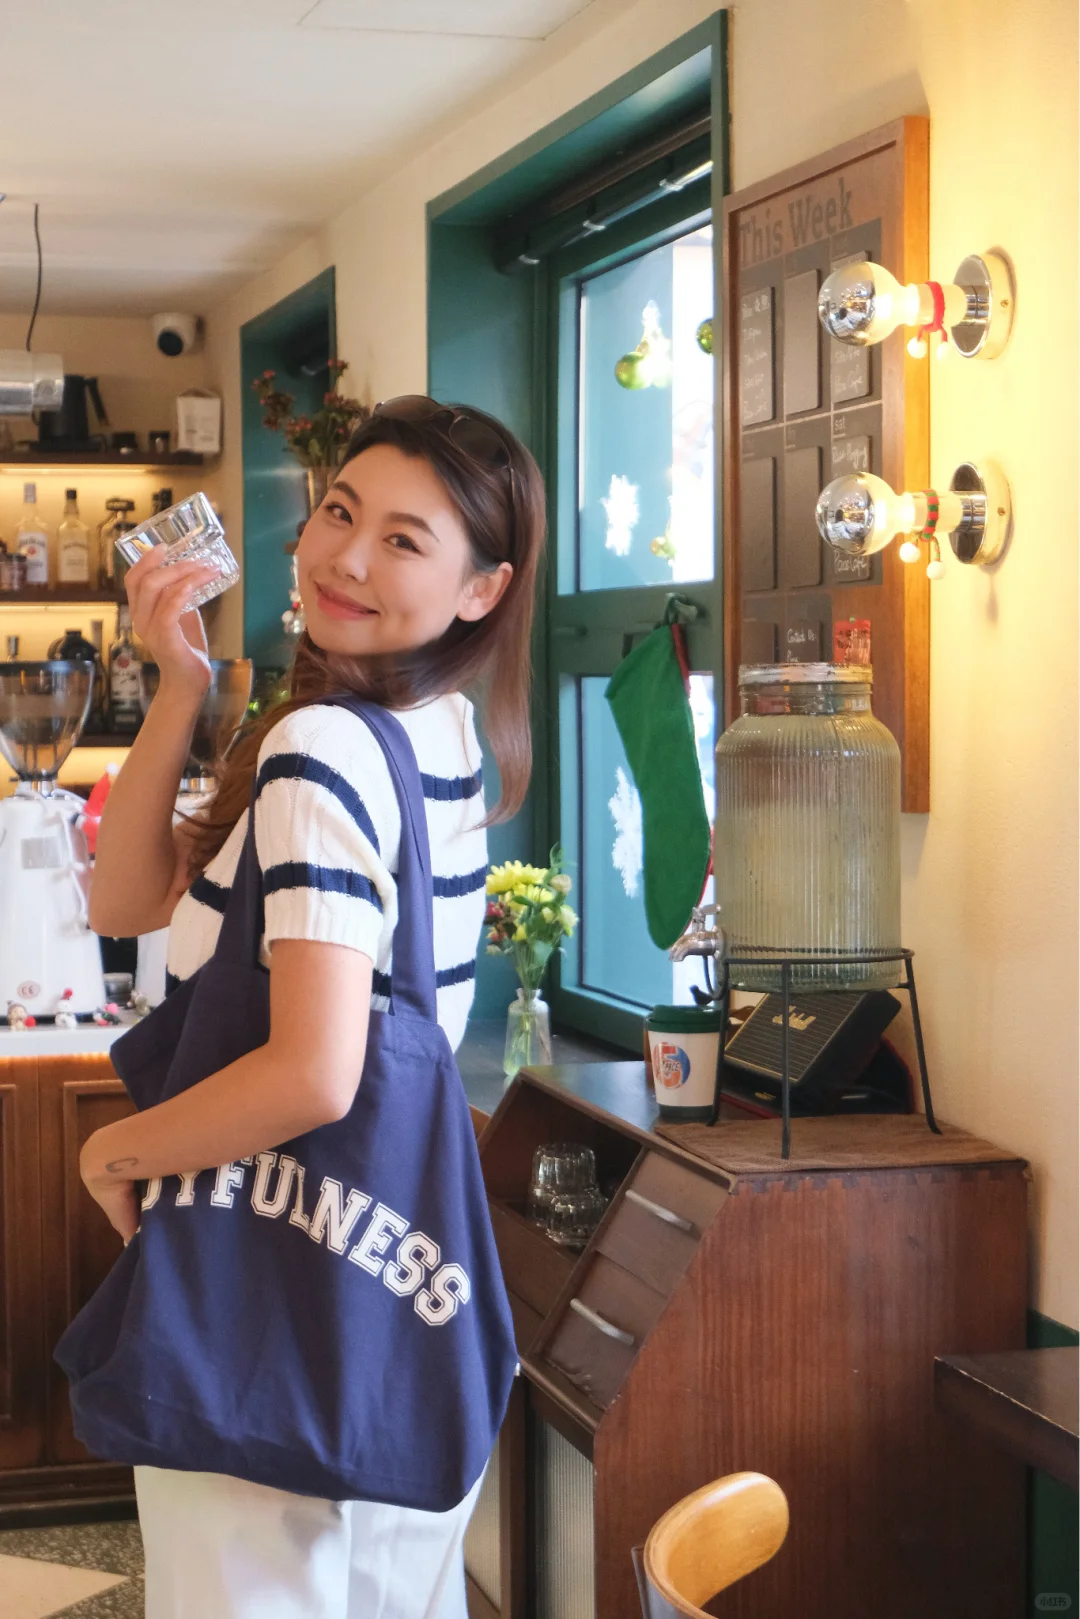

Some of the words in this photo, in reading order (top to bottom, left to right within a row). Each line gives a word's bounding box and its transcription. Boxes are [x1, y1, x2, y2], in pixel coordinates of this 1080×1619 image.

[739, 208, 783, 266] This
[788, 177, 853, 247] Week
[834, 416, 846, 431] sat
